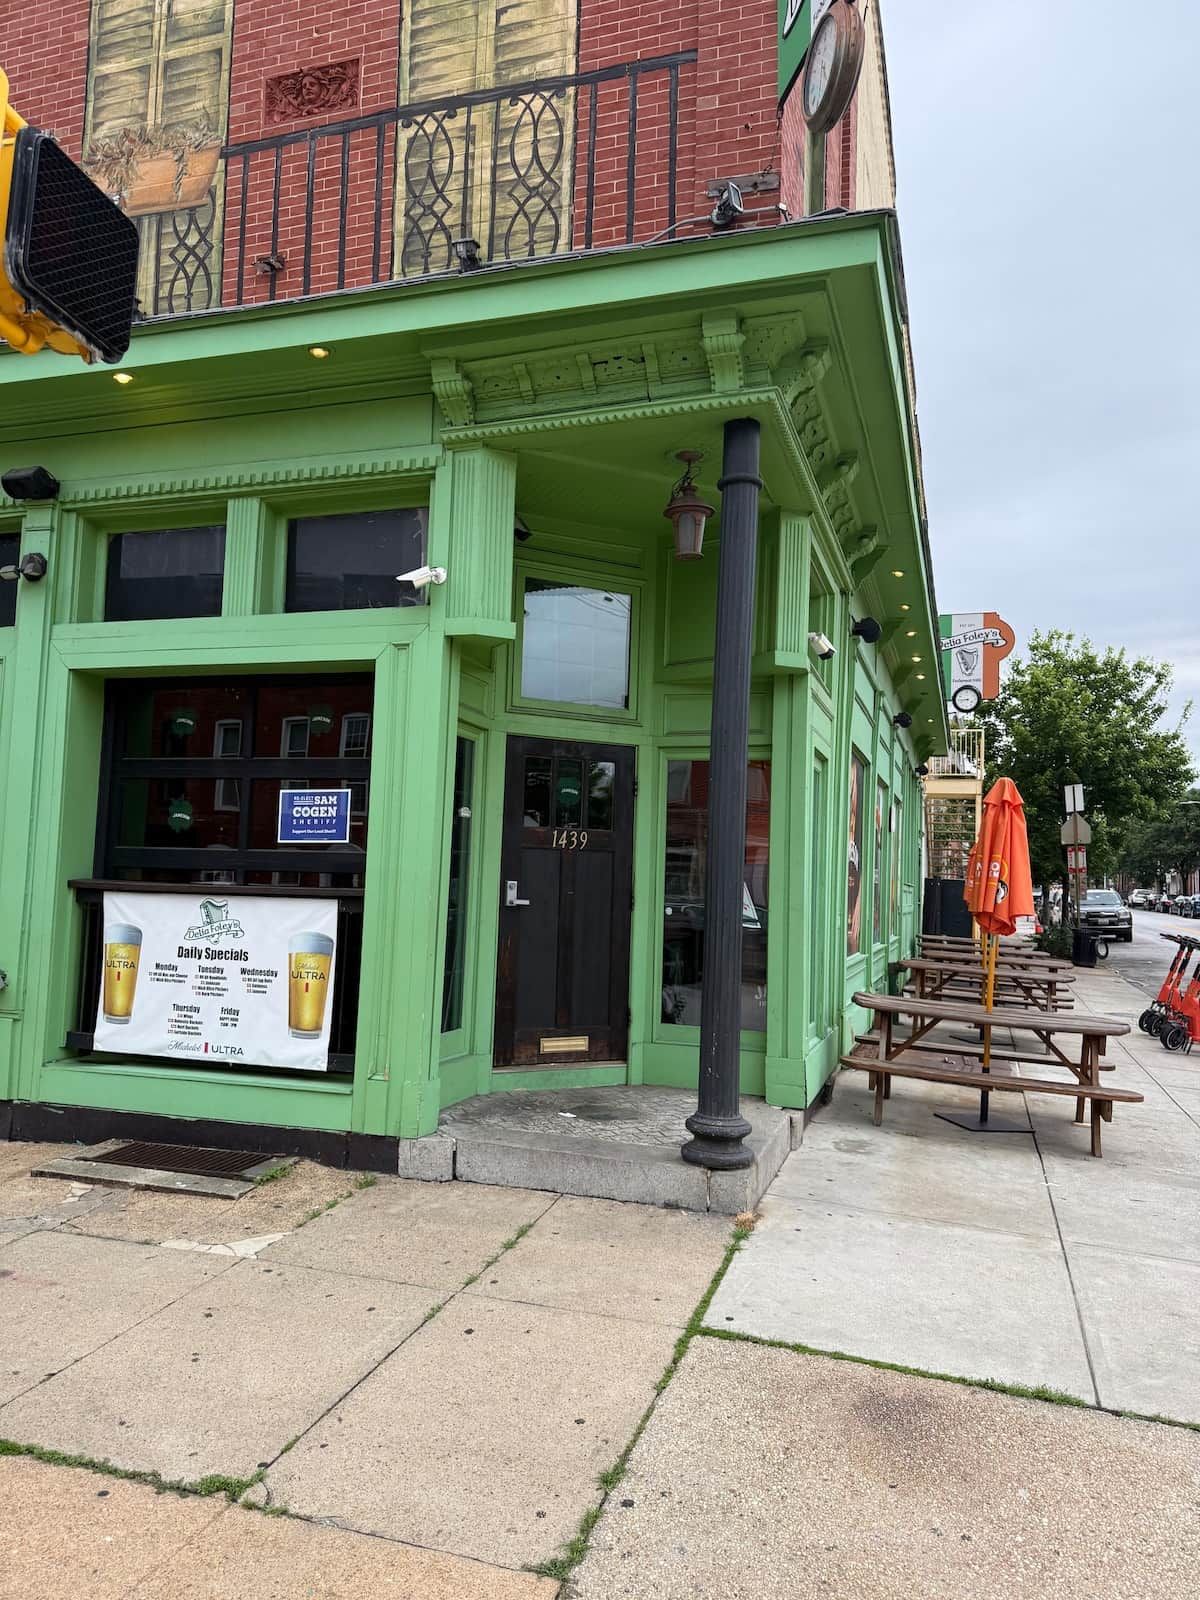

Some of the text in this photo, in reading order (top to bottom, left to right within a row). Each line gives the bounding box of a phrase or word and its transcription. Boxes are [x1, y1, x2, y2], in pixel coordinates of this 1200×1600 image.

[963, 630, 998, 643] Foley's
[314, 796, 337, 804] SAM
[293, 807, 337, 817] COGEN
[552, 830, 588, 849] 1439
[188, 921, 239, 938] Delia Foley's
[177, 946, 249, 961] Daily Specials
[106, 960, 136, 969] ULTRA
[155, 962, 178, 972] Monday
[198, 965, 224, 975] Tuesday
[240, 967, 278, 978] Wednesday
[291, 970, 326, 980] ULTRA
[172, 1003, 200, 1014] Thursday
[221, 1007, 240, 1016] Friday
[212, 1045, 244, 1055] ULTRA
